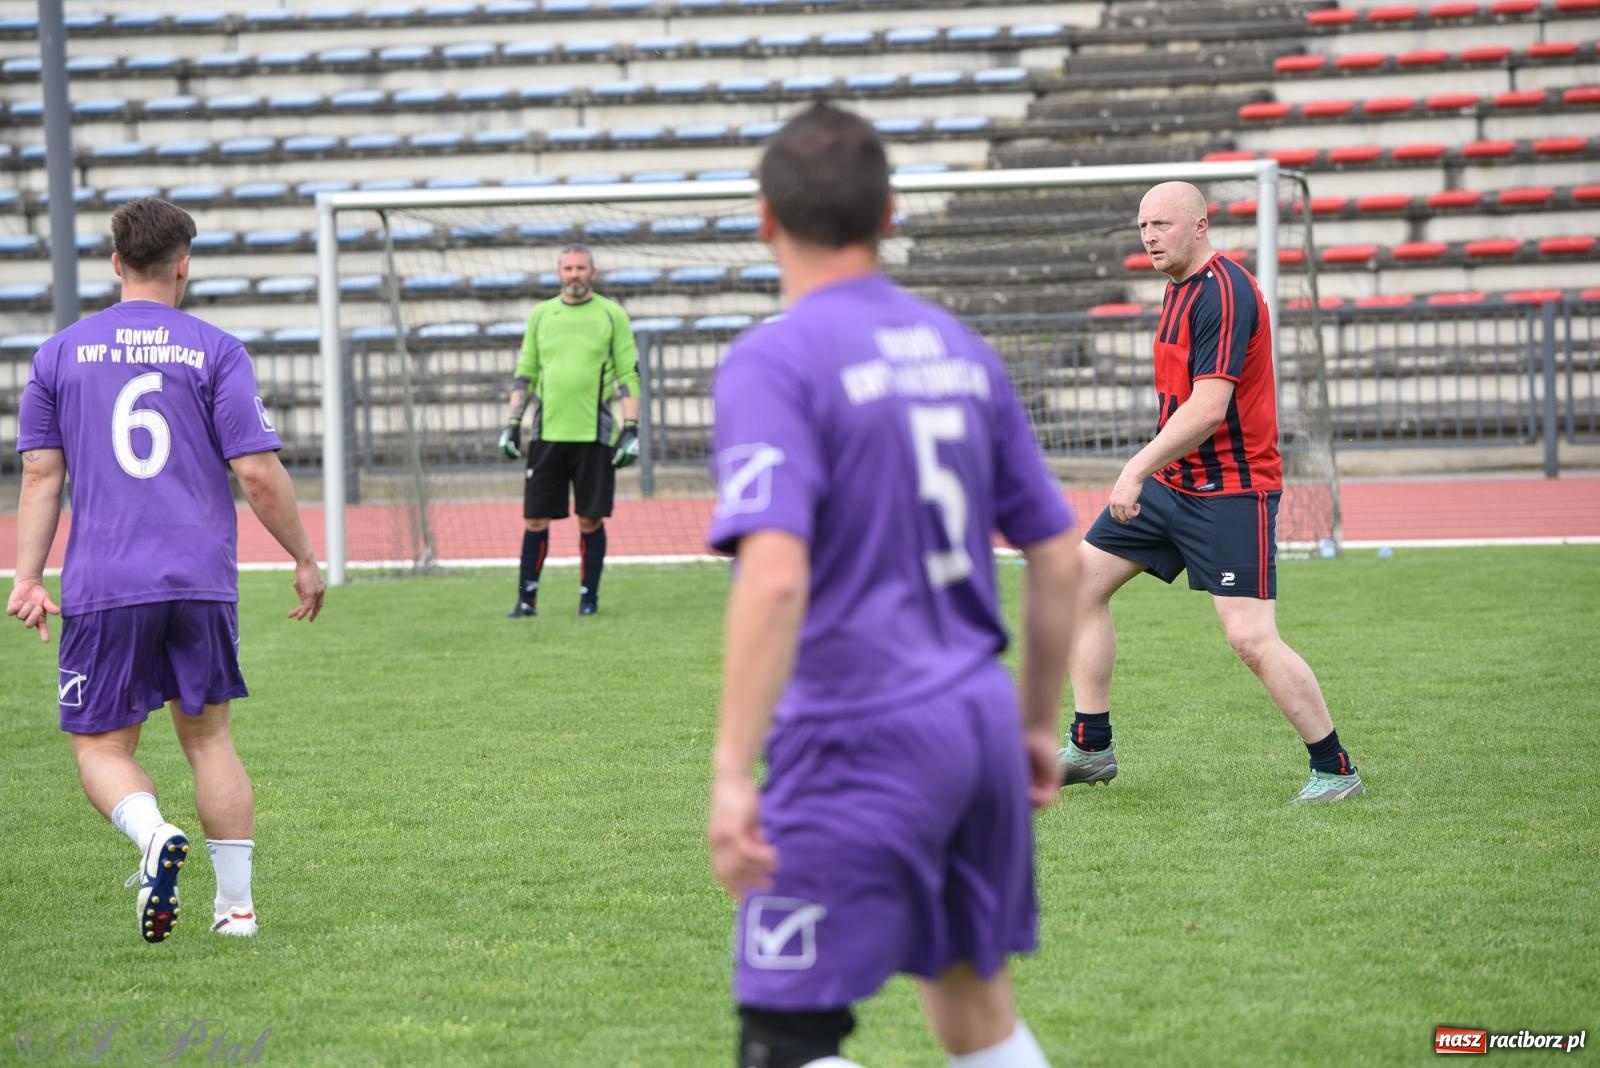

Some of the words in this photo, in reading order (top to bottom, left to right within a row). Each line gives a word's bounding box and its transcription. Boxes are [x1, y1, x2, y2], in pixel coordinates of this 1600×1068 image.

[77, 344, 107, 363] KWP
[126, 345, 205, 369] KATOWICACH
[115, 326, 169, 345] KONWÓJ
[112, 371, 171, 479] 6
[910, 405, 974, 587] 5
